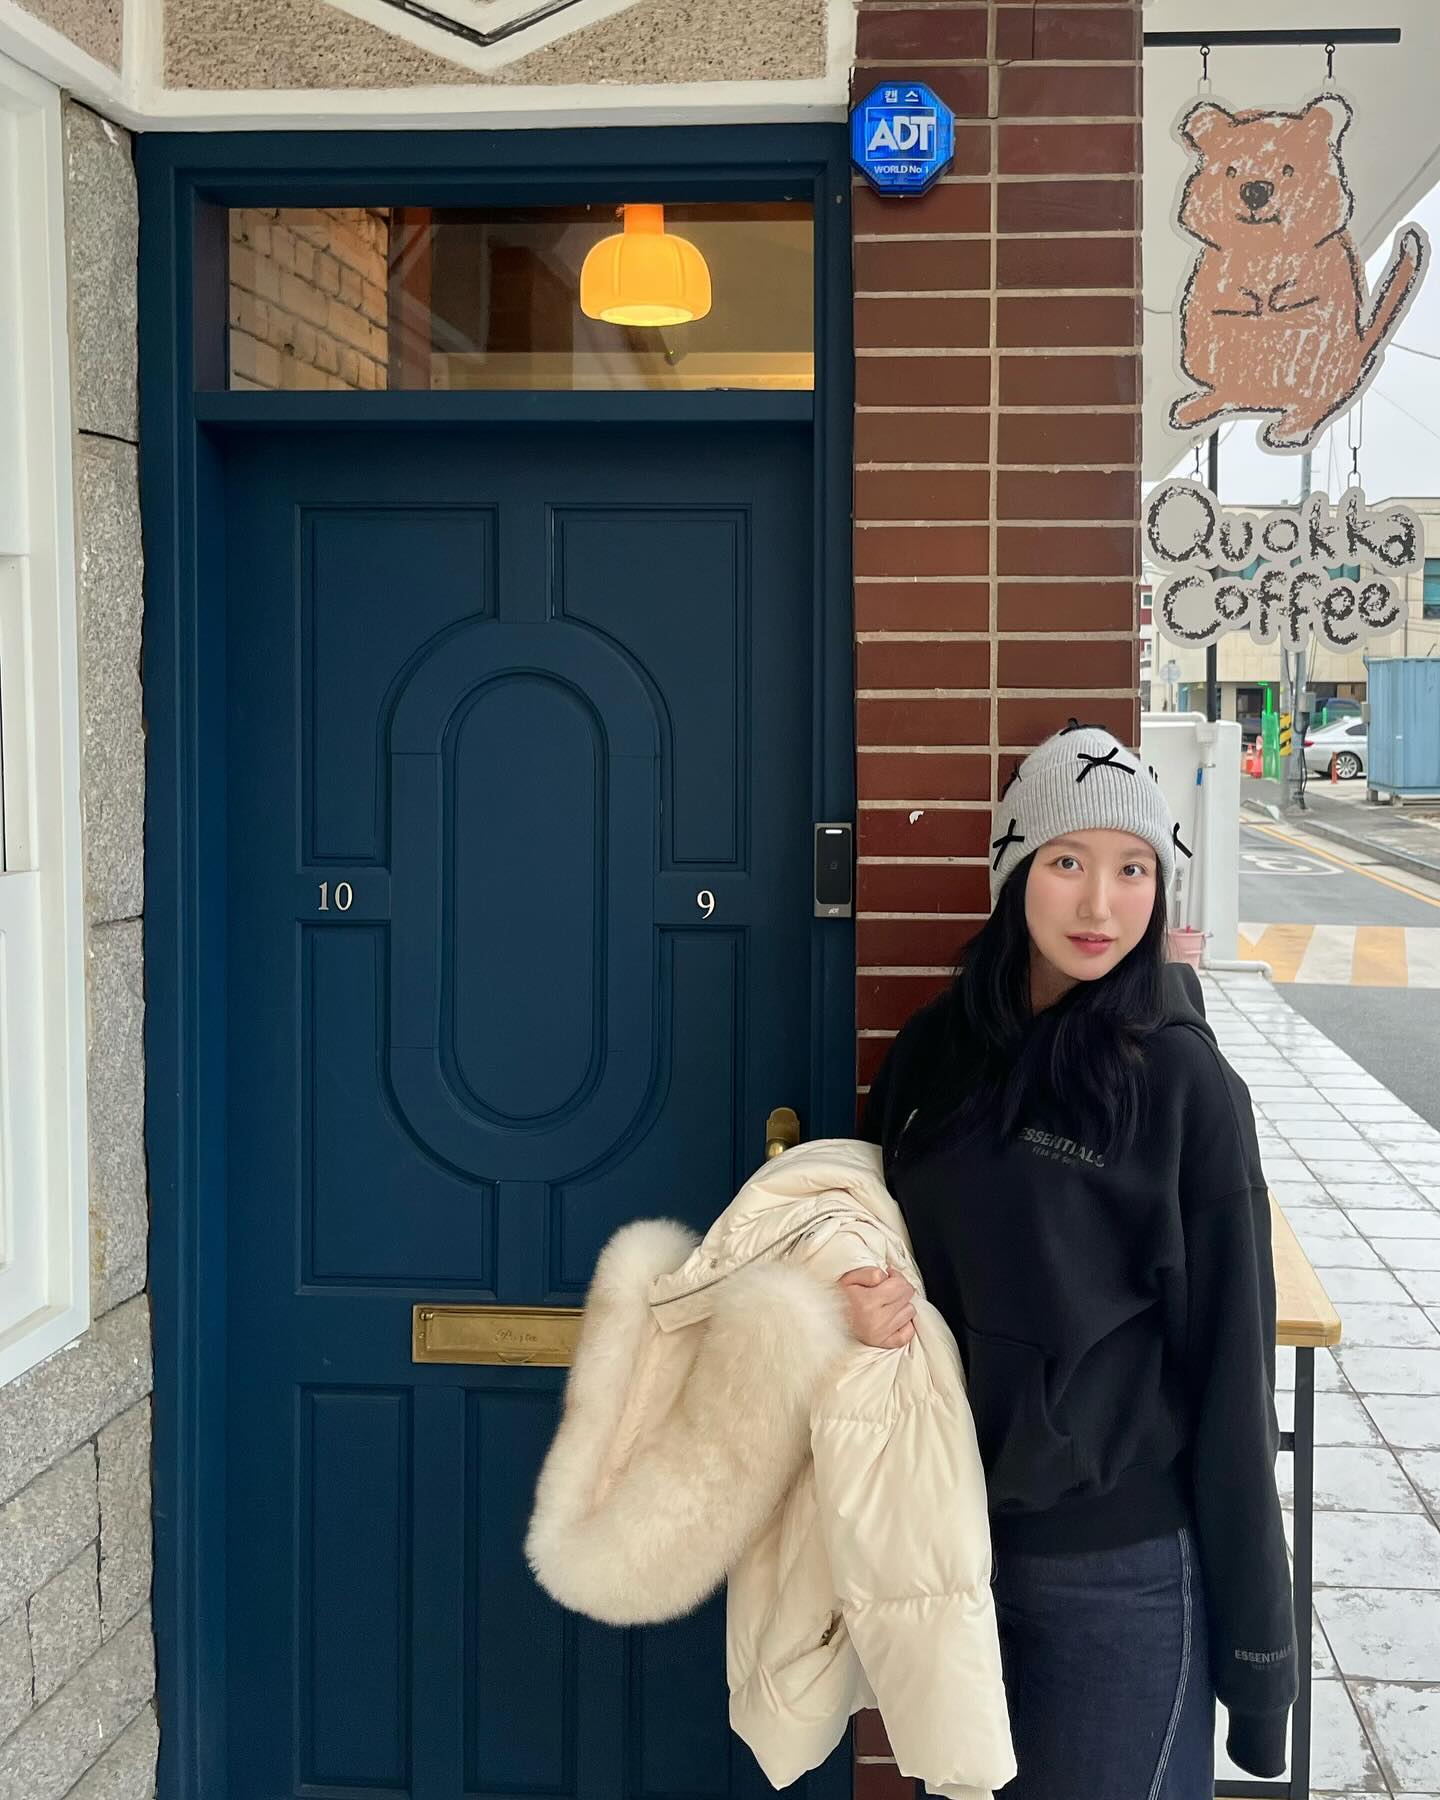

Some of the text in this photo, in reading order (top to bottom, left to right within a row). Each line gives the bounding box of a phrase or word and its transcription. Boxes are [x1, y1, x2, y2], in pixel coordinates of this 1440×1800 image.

[867, 115, 936, 151] ADT
[874, 165, 908, 174] WORLD
[1148, 485, 1416, 568] Quokka
[1163, 569, 1400, 646] Coffee
[318, 881, 353, 911] 10
[697, 890, 715, 920] 9
